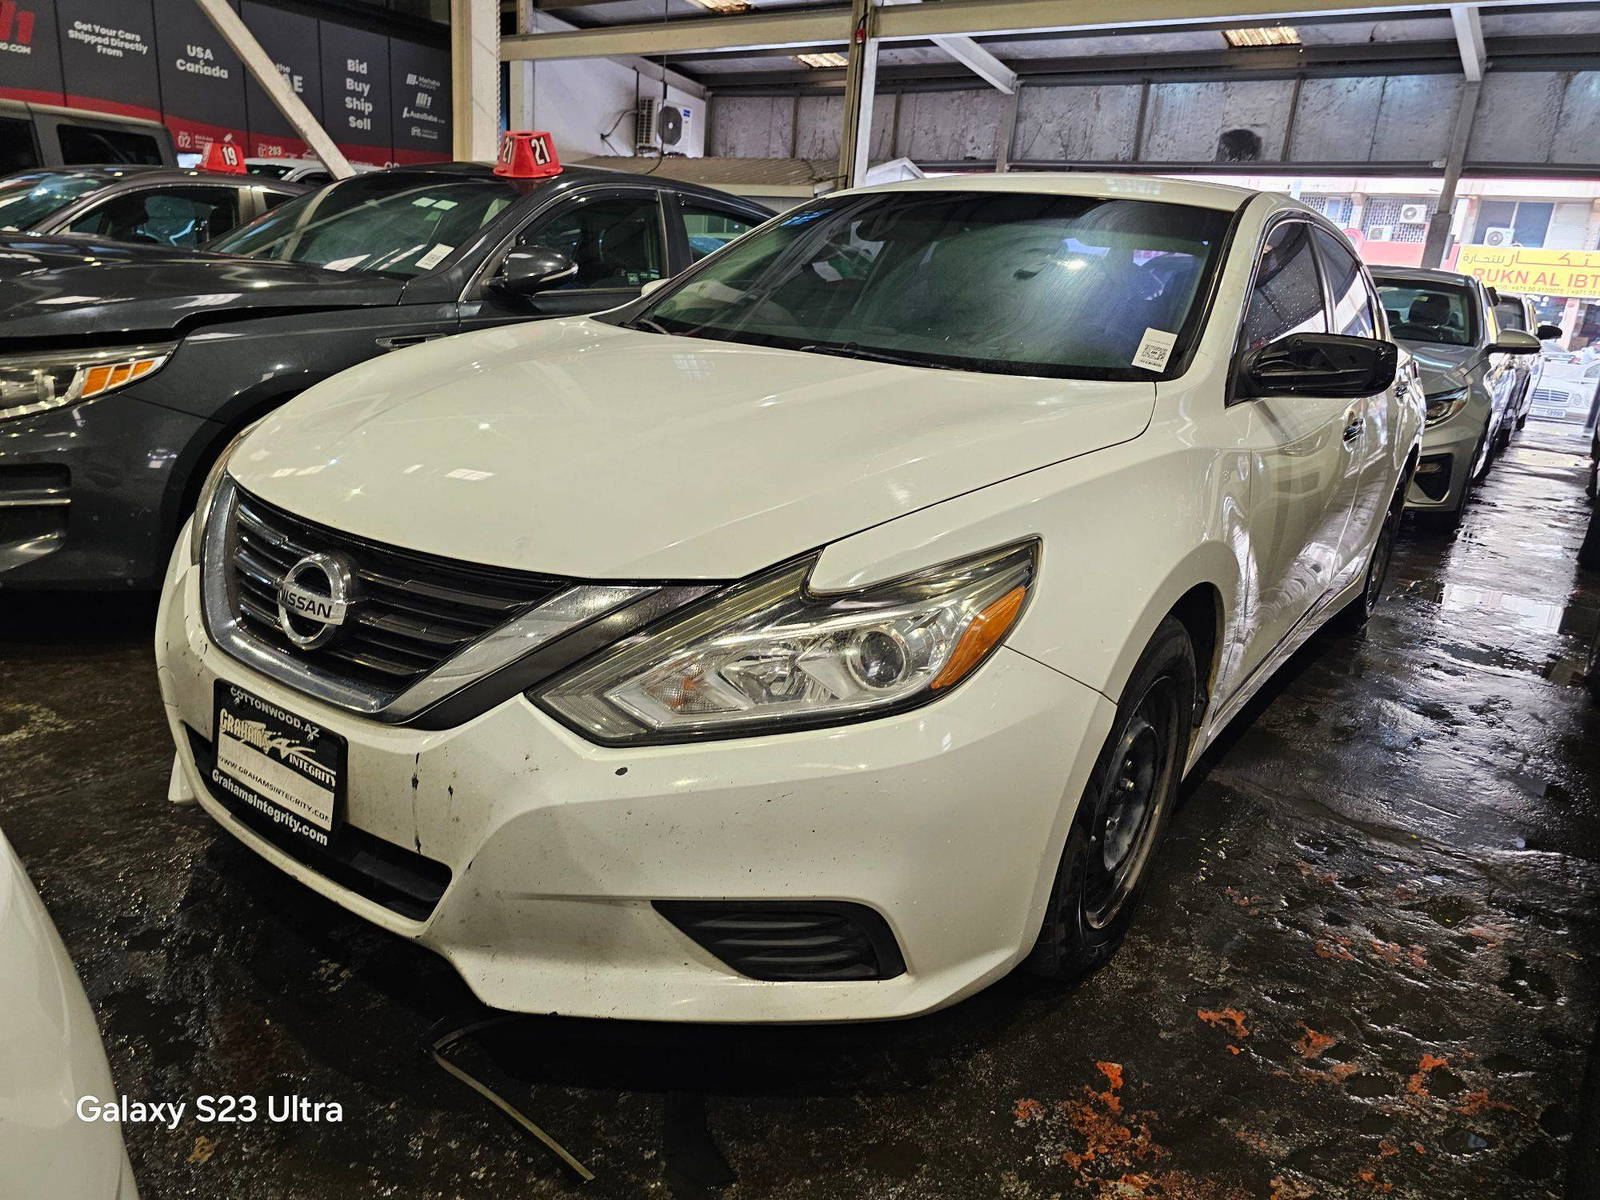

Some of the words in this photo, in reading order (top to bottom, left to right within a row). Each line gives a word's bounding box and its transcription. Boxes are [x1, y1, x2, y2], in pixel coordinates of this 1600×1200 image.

[74, 21, 92, 33] Get
[93, 25, 117, 38] Your
[117, 30, 141, 42] Cars
[67, 29, 109, 46] Shipped
[110, 38, 148, 55] Directly
[96, 45, 123, 57] From
[186, 44, 214, 61] USA
[176, 59, 229, 79] Canada
[346, 58, 368, 75] Bid
[346, 77, 371, 97] Buy
[345, 96, 373, 116] Ship
[348, 115, 371, 131] Sell
[178, 134, 192, 149] 02
[502, 137, 513, 164] 21
[531, 137, 551, 166] 21
[222, 145, 239, 166] 19
[1471, 267, 1530, 285] RUKN
[1532, 271, 1561, 287] AL
[278, 587, 332, 619] NISSAN
[289, 753, 336, 787] INTEGRITY
[212, 768, 328, 847] GrahamsIntegrity.com
